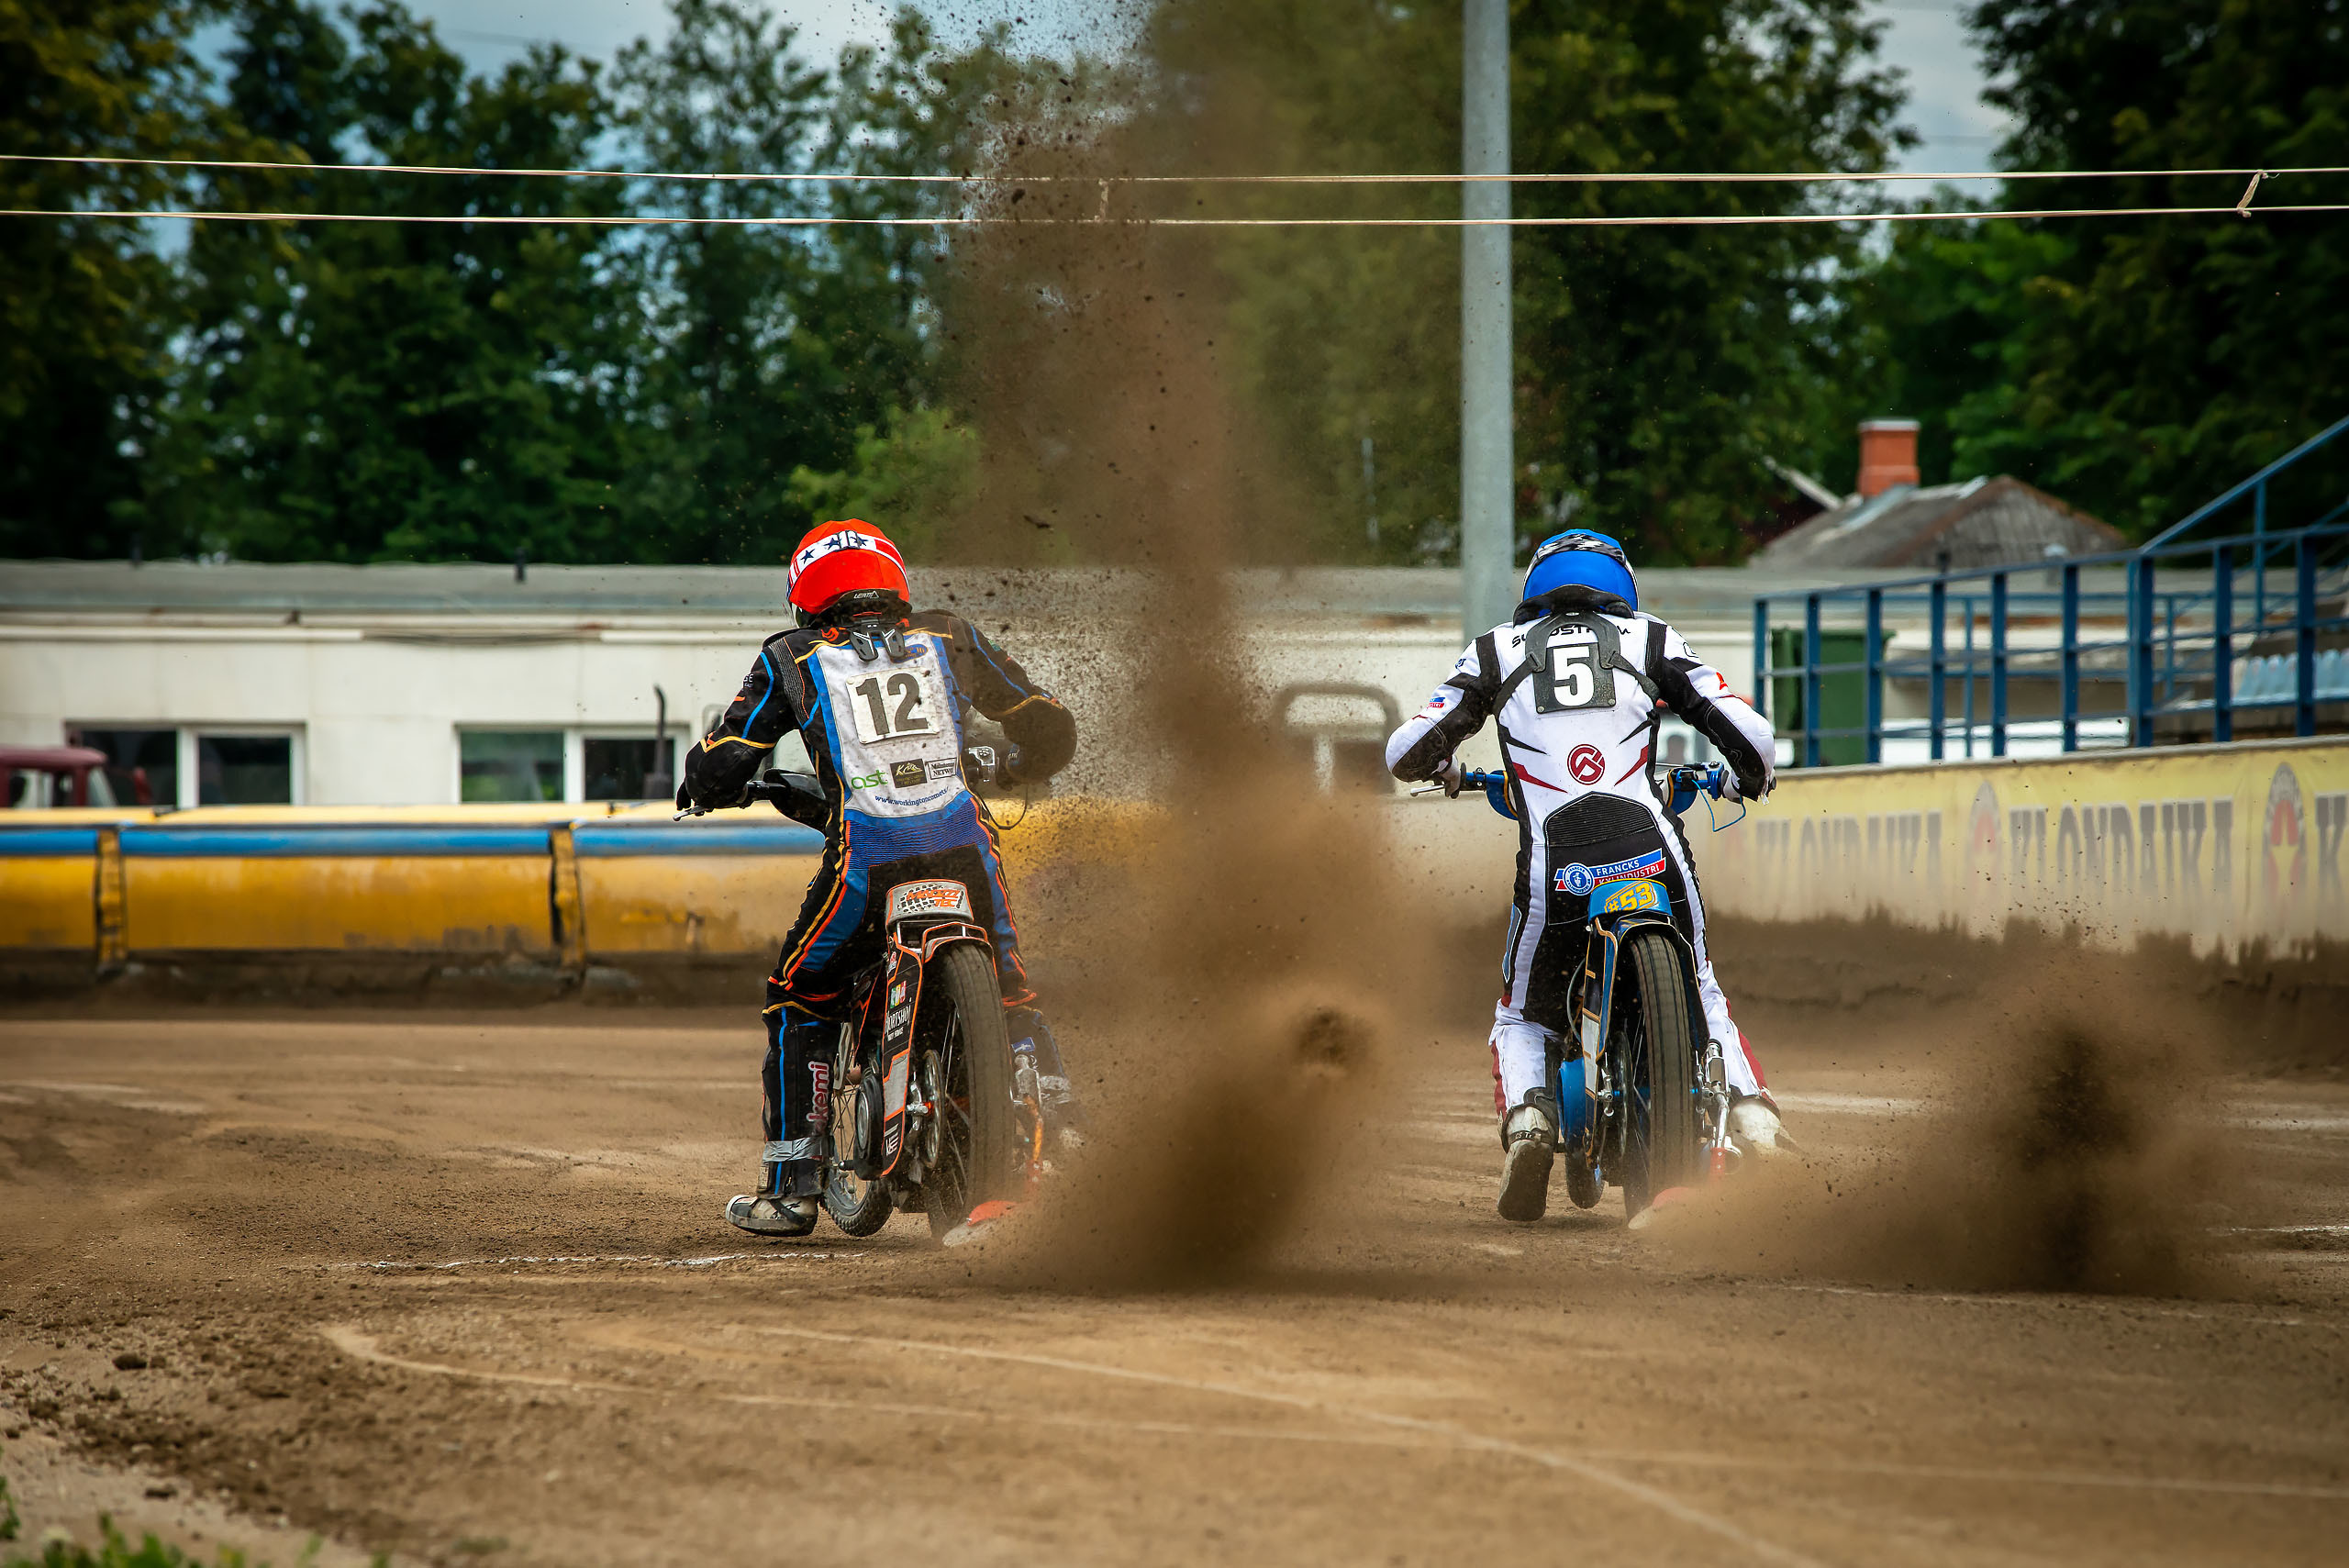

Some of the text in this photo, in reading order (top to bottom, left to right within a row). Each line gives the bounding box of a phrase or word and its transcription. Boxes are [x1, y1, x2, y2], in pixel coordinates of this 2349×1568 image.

[1553, 645, 1595, 706] 5
[855, 673, 929, 736] 12
[1596, 859, 1640, 877] FRANCKS
[1607, 882, 1653, 913] #53
